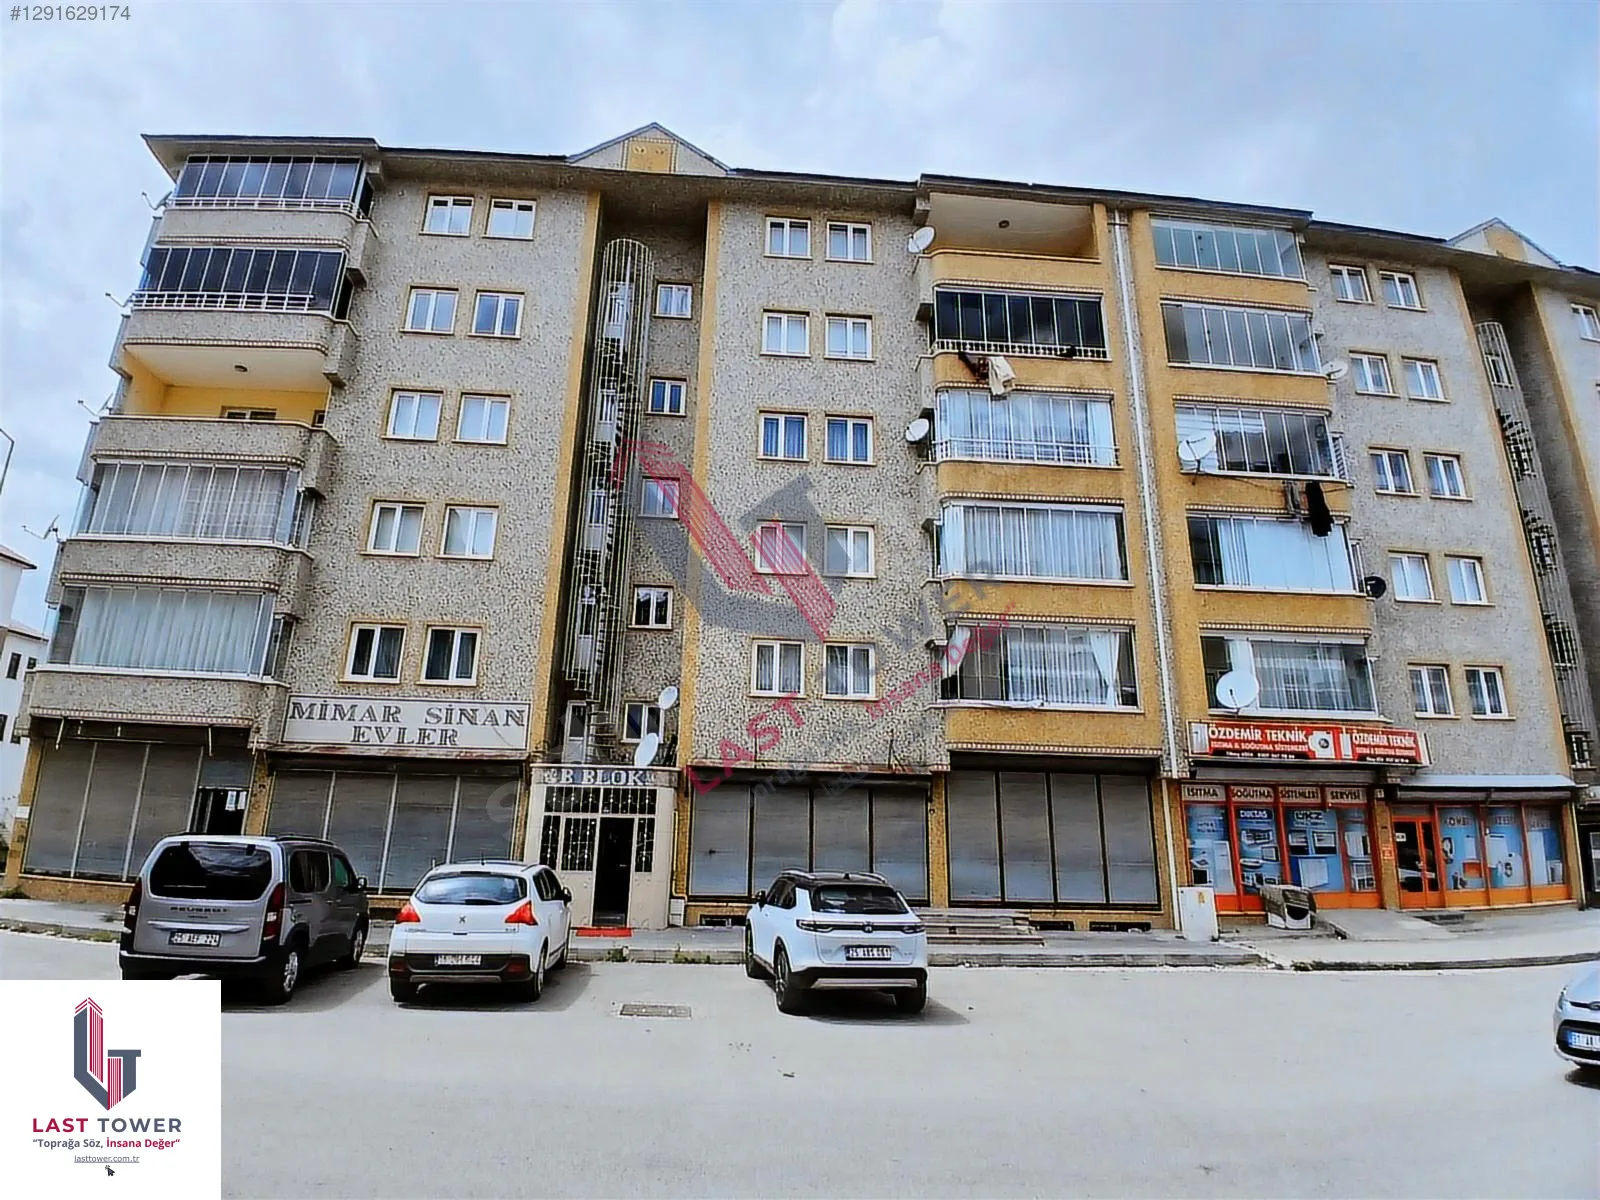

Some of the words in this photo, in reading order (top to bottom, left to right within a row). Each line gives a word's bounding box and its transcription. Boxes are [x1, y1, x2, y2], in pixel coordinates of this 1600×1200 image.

[289, 700, 400, 722] MİMAR
[425, 704, 526, 727] SİNAN
[351, 725, 458, 746] EVLER
[1208, 724, 1262, 741] ÖZDEMİR
[1264, 727, 1308, 743] TEKNİK
[1352, 730, 1388, 746] ÖZDEMİR
[560, 768, 574, 783] B
[582, 769, 643, 786] BLOK
[1186, 786, 1218, 797] ISITMA
[1232, 786, 1273, 799] SOĞUTMA
[1330, 788, 1361, 800] SERVİSİ
